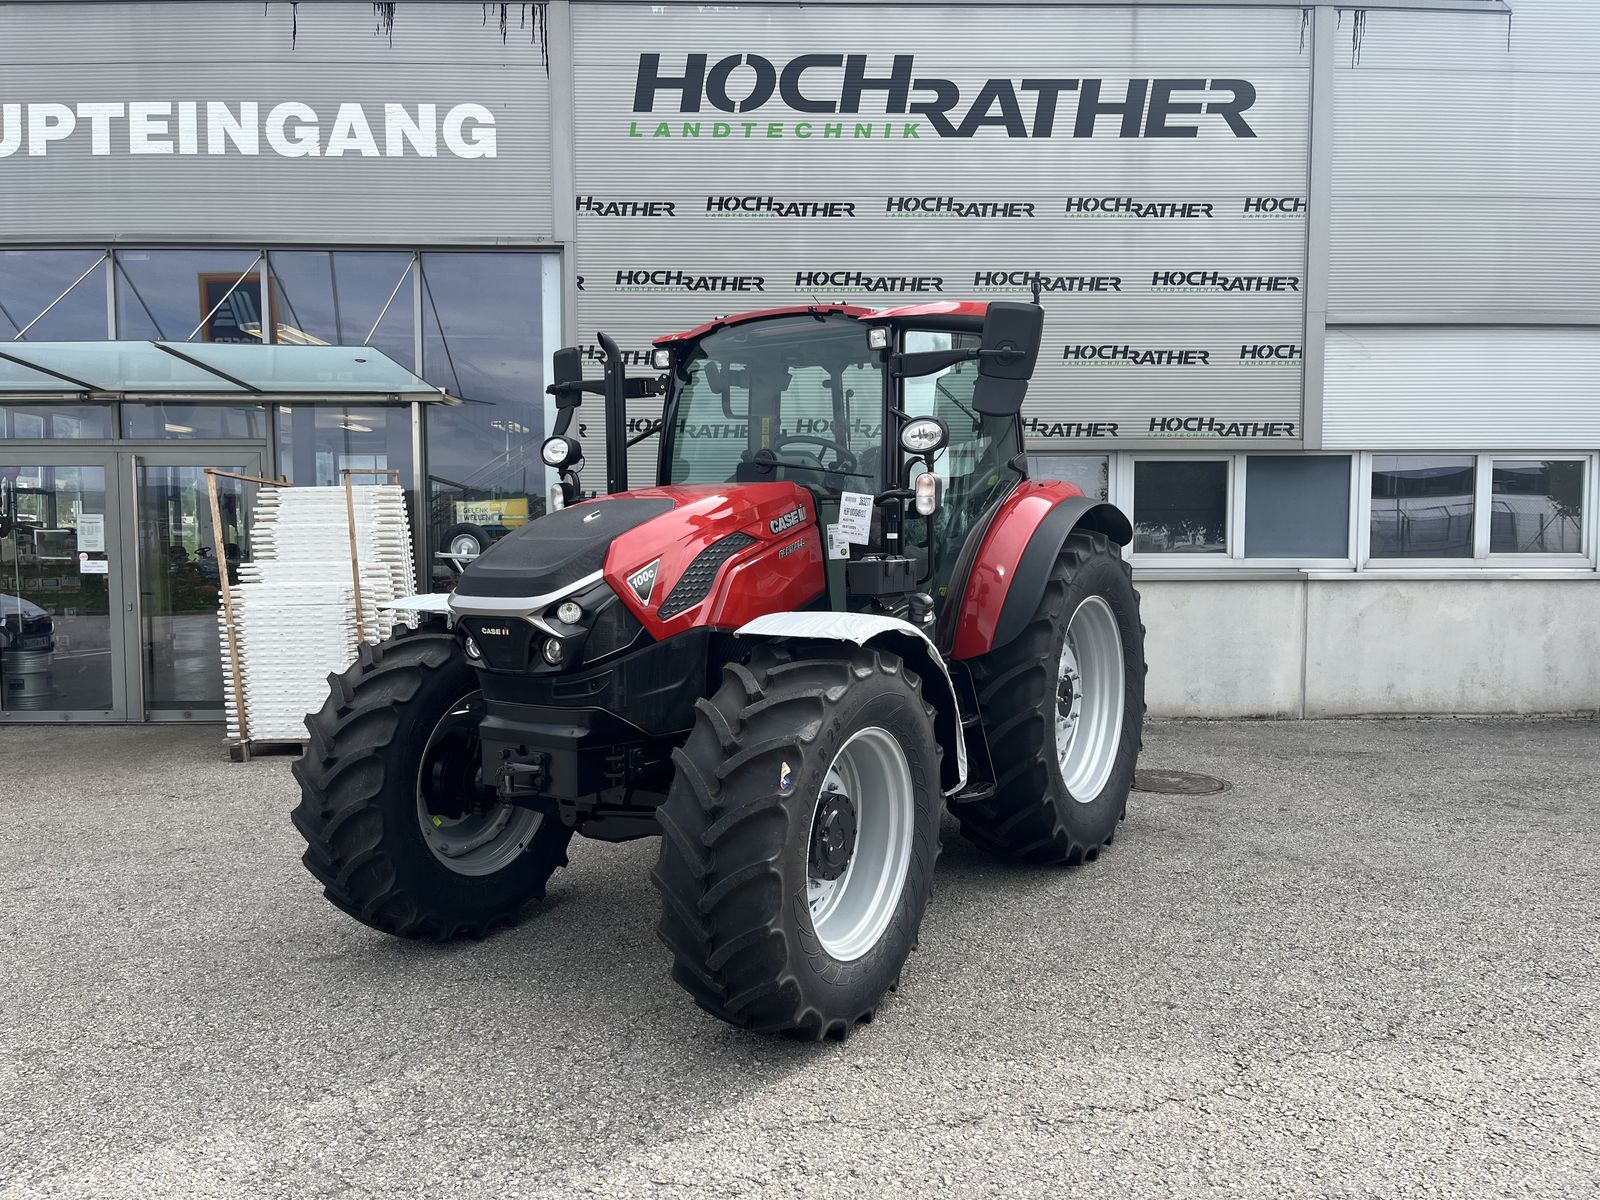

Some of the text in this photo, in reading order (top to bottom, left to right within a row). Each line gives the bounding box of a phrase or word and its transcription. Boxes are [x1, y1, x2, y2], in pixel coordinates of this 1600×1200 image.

[633, 53, 1257, 138] HOCHRATHER
[629, 122, 920, 138] LANDTECHNIK
[706, 196, 856, 217] HOCHRATHER
[886, 197, 1035, 217] HOCHRATHER
[1065, 197, 1214, 217] HOCHRATHER
[1244, 197, 1306, 212] HOCH
[616, 270, 765, 291] HOCHRATHER
[795, 271, 943, 291] HOCHRATHER
[974, 271, 1121, 291] HOCHRATHER
[1152, 271, 1299, 291] HOCHRATHER
[1063, 345, 1209, 365] HOCHRATHER
[1240, 345, 1303, 359] HOCH
[1149, 417, 1295, 437] HOCHRATHER
[770, 510, 798, 534] CASE
[481, 627, 501, 635] CASE
[827, 717, 842, 743] 28
